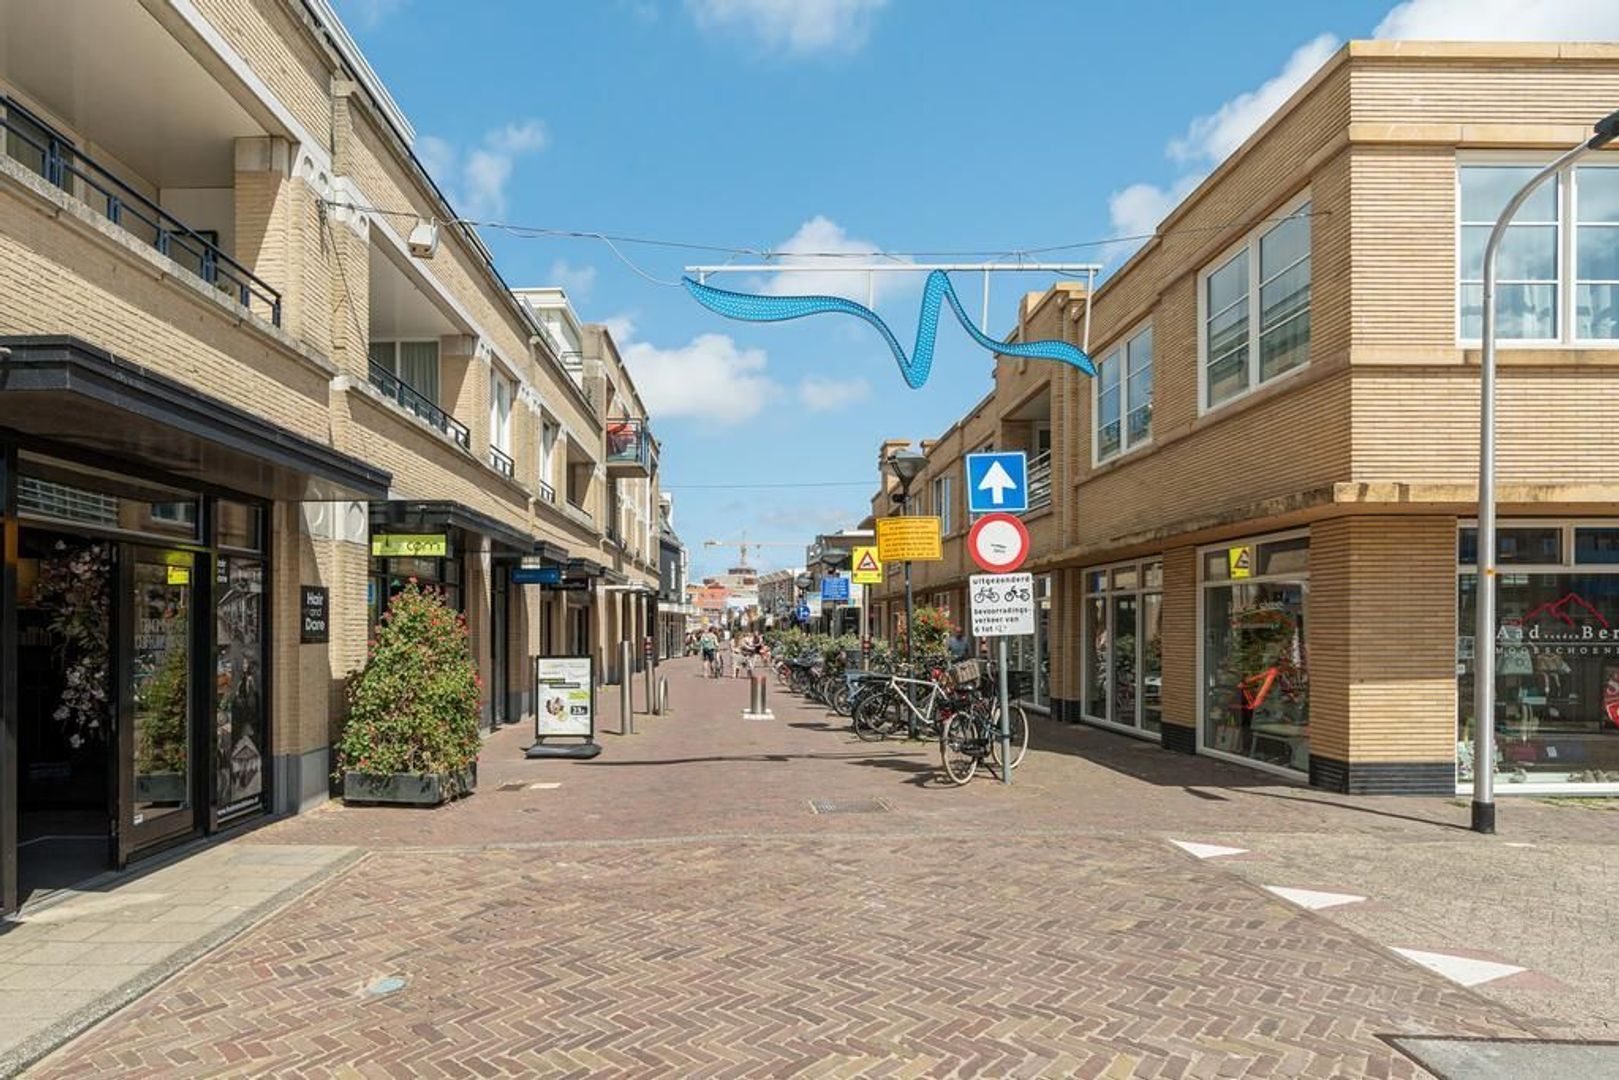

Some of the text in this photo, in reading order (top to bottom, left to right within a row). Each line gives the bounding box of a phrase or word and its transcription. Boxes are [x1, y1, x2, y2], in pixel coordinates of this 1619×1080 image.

[972, 576, 1030, 585] uitgezonderd
[306, 591, 324, 605] Hair
[310, 608, 322, 617] and
[305, 617, 326, 631] Dare
[975, 616, 1003, 624] verkeer
[1497, 625, 1540, 639] Aad
